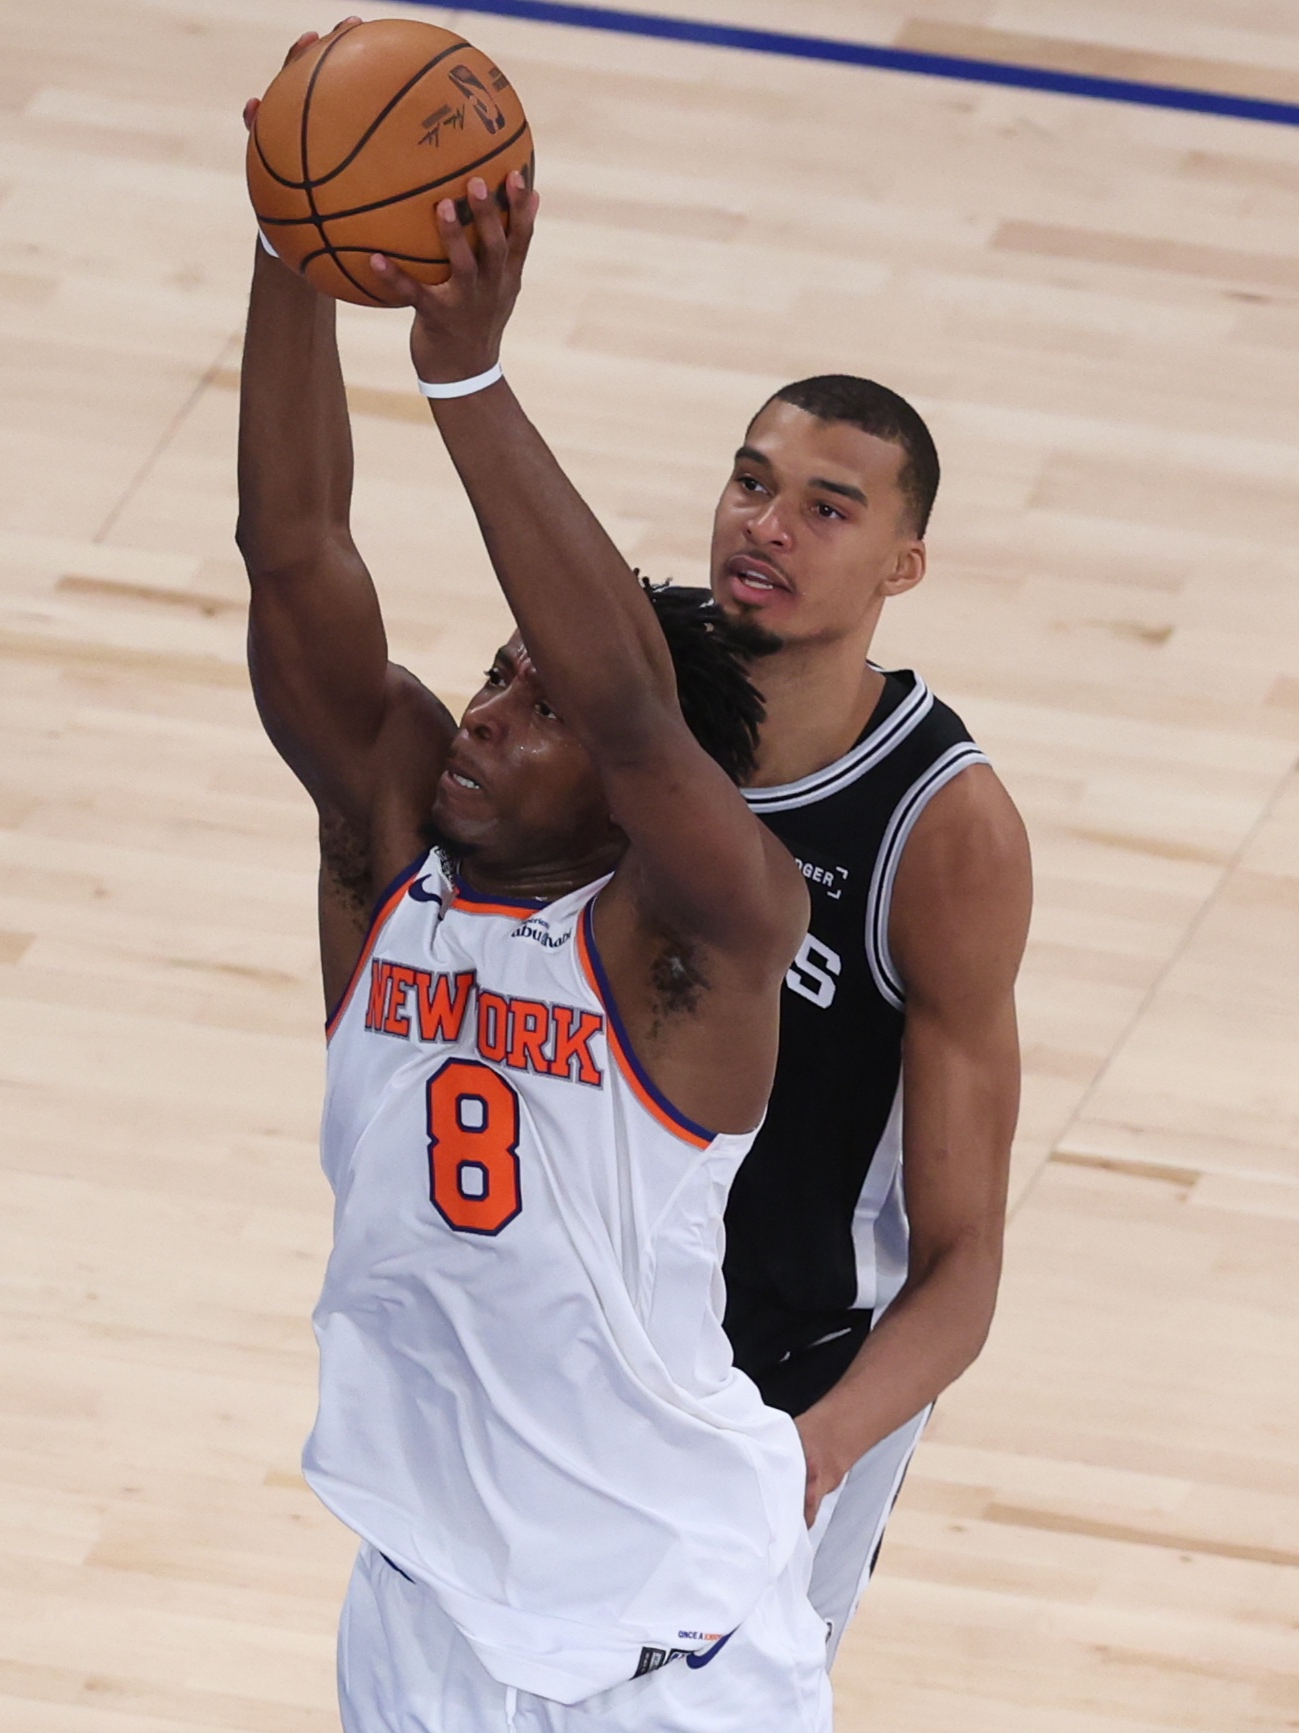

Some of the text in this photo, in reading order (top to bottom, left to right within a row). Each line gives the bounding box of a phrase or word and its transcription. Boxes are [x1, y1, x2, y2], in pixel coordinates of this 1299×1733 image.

[365, 957, 605, 1091] NEW ORK
[785, 932, 842, 1010] S
[426, 1057, 523, 1237] 8
